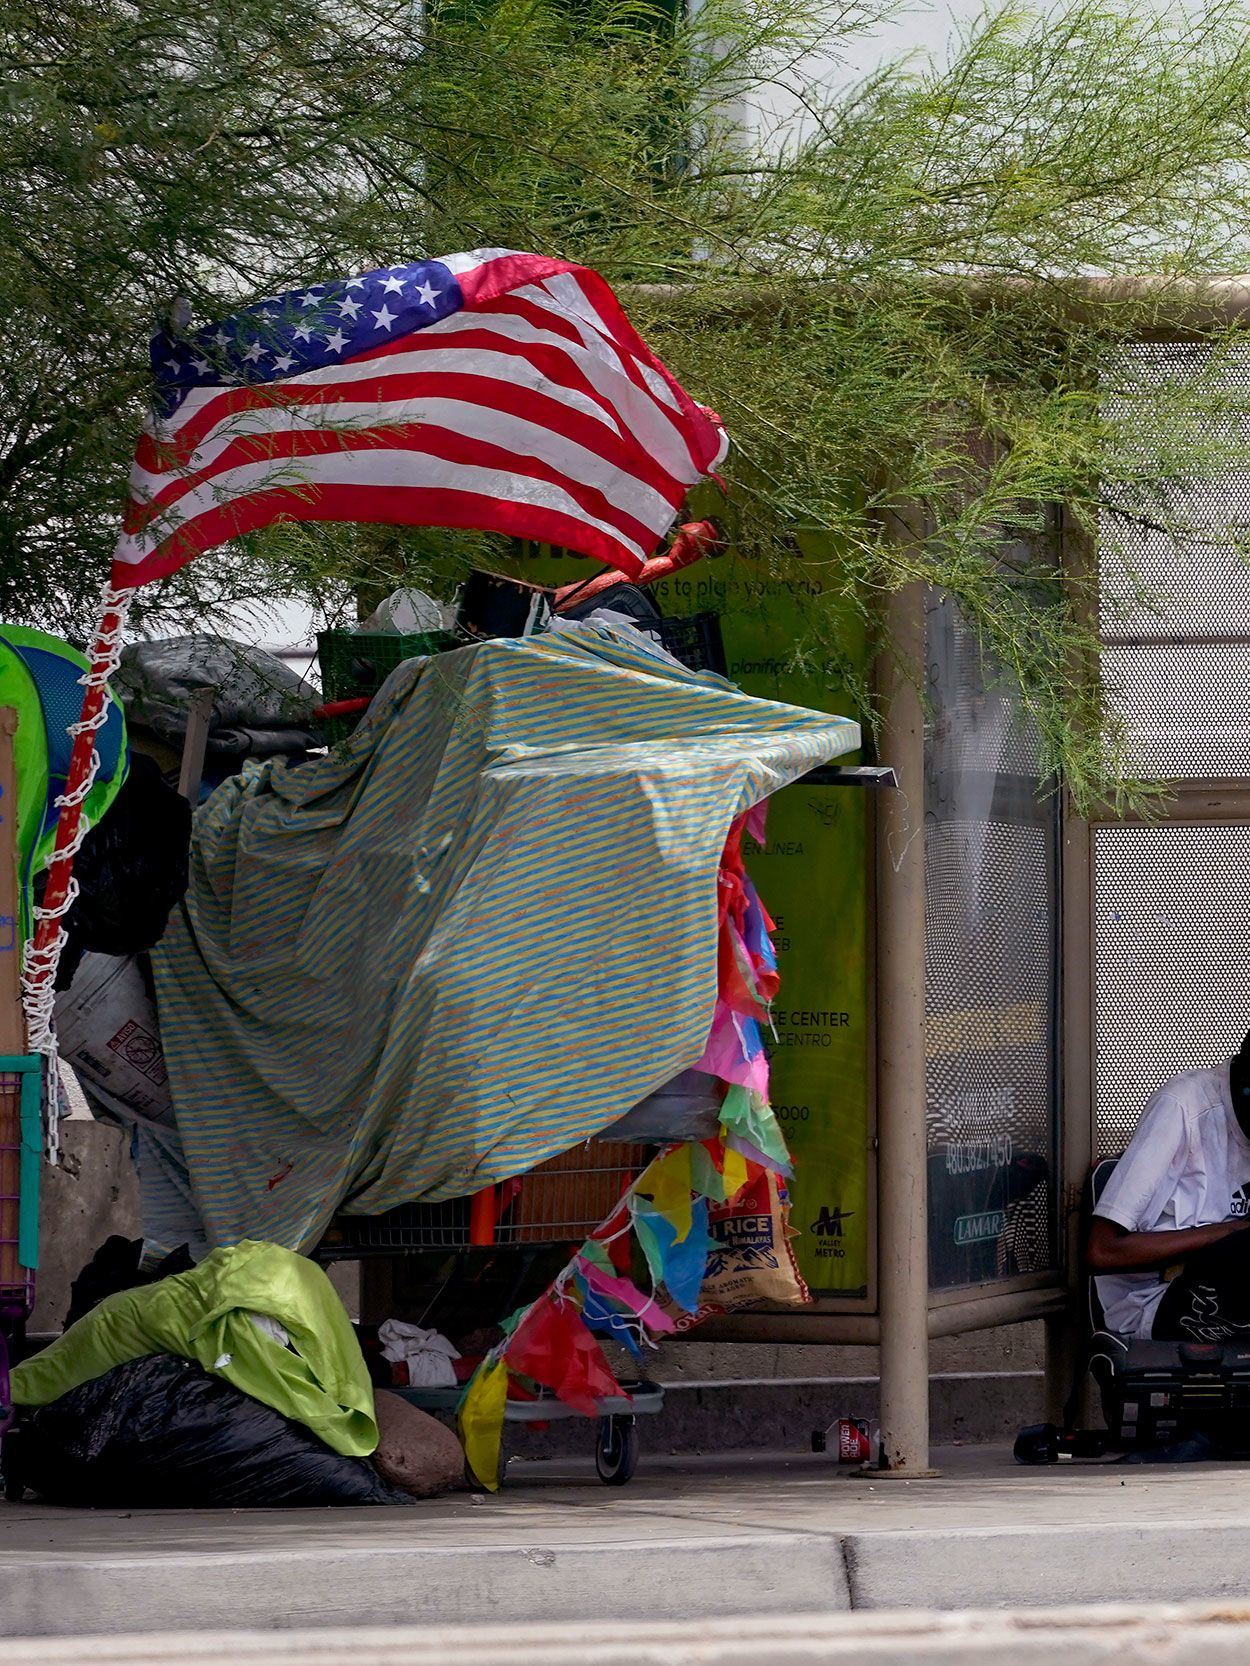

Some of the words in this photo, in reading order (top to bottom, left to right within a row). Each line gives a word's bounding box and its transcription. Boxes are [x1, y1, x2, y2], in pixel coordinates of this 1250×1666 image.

[791, 1011, 850, 1027] CENTER
[723, 1217, 769, 1236] RICE
[958, 1215, 1000, 1241] LAMAR
[819, 1239, 841, 1247] VALLEY
[814, 1248, 846, 1258] METRO
[841, 1424, 850, 1458] POWER
